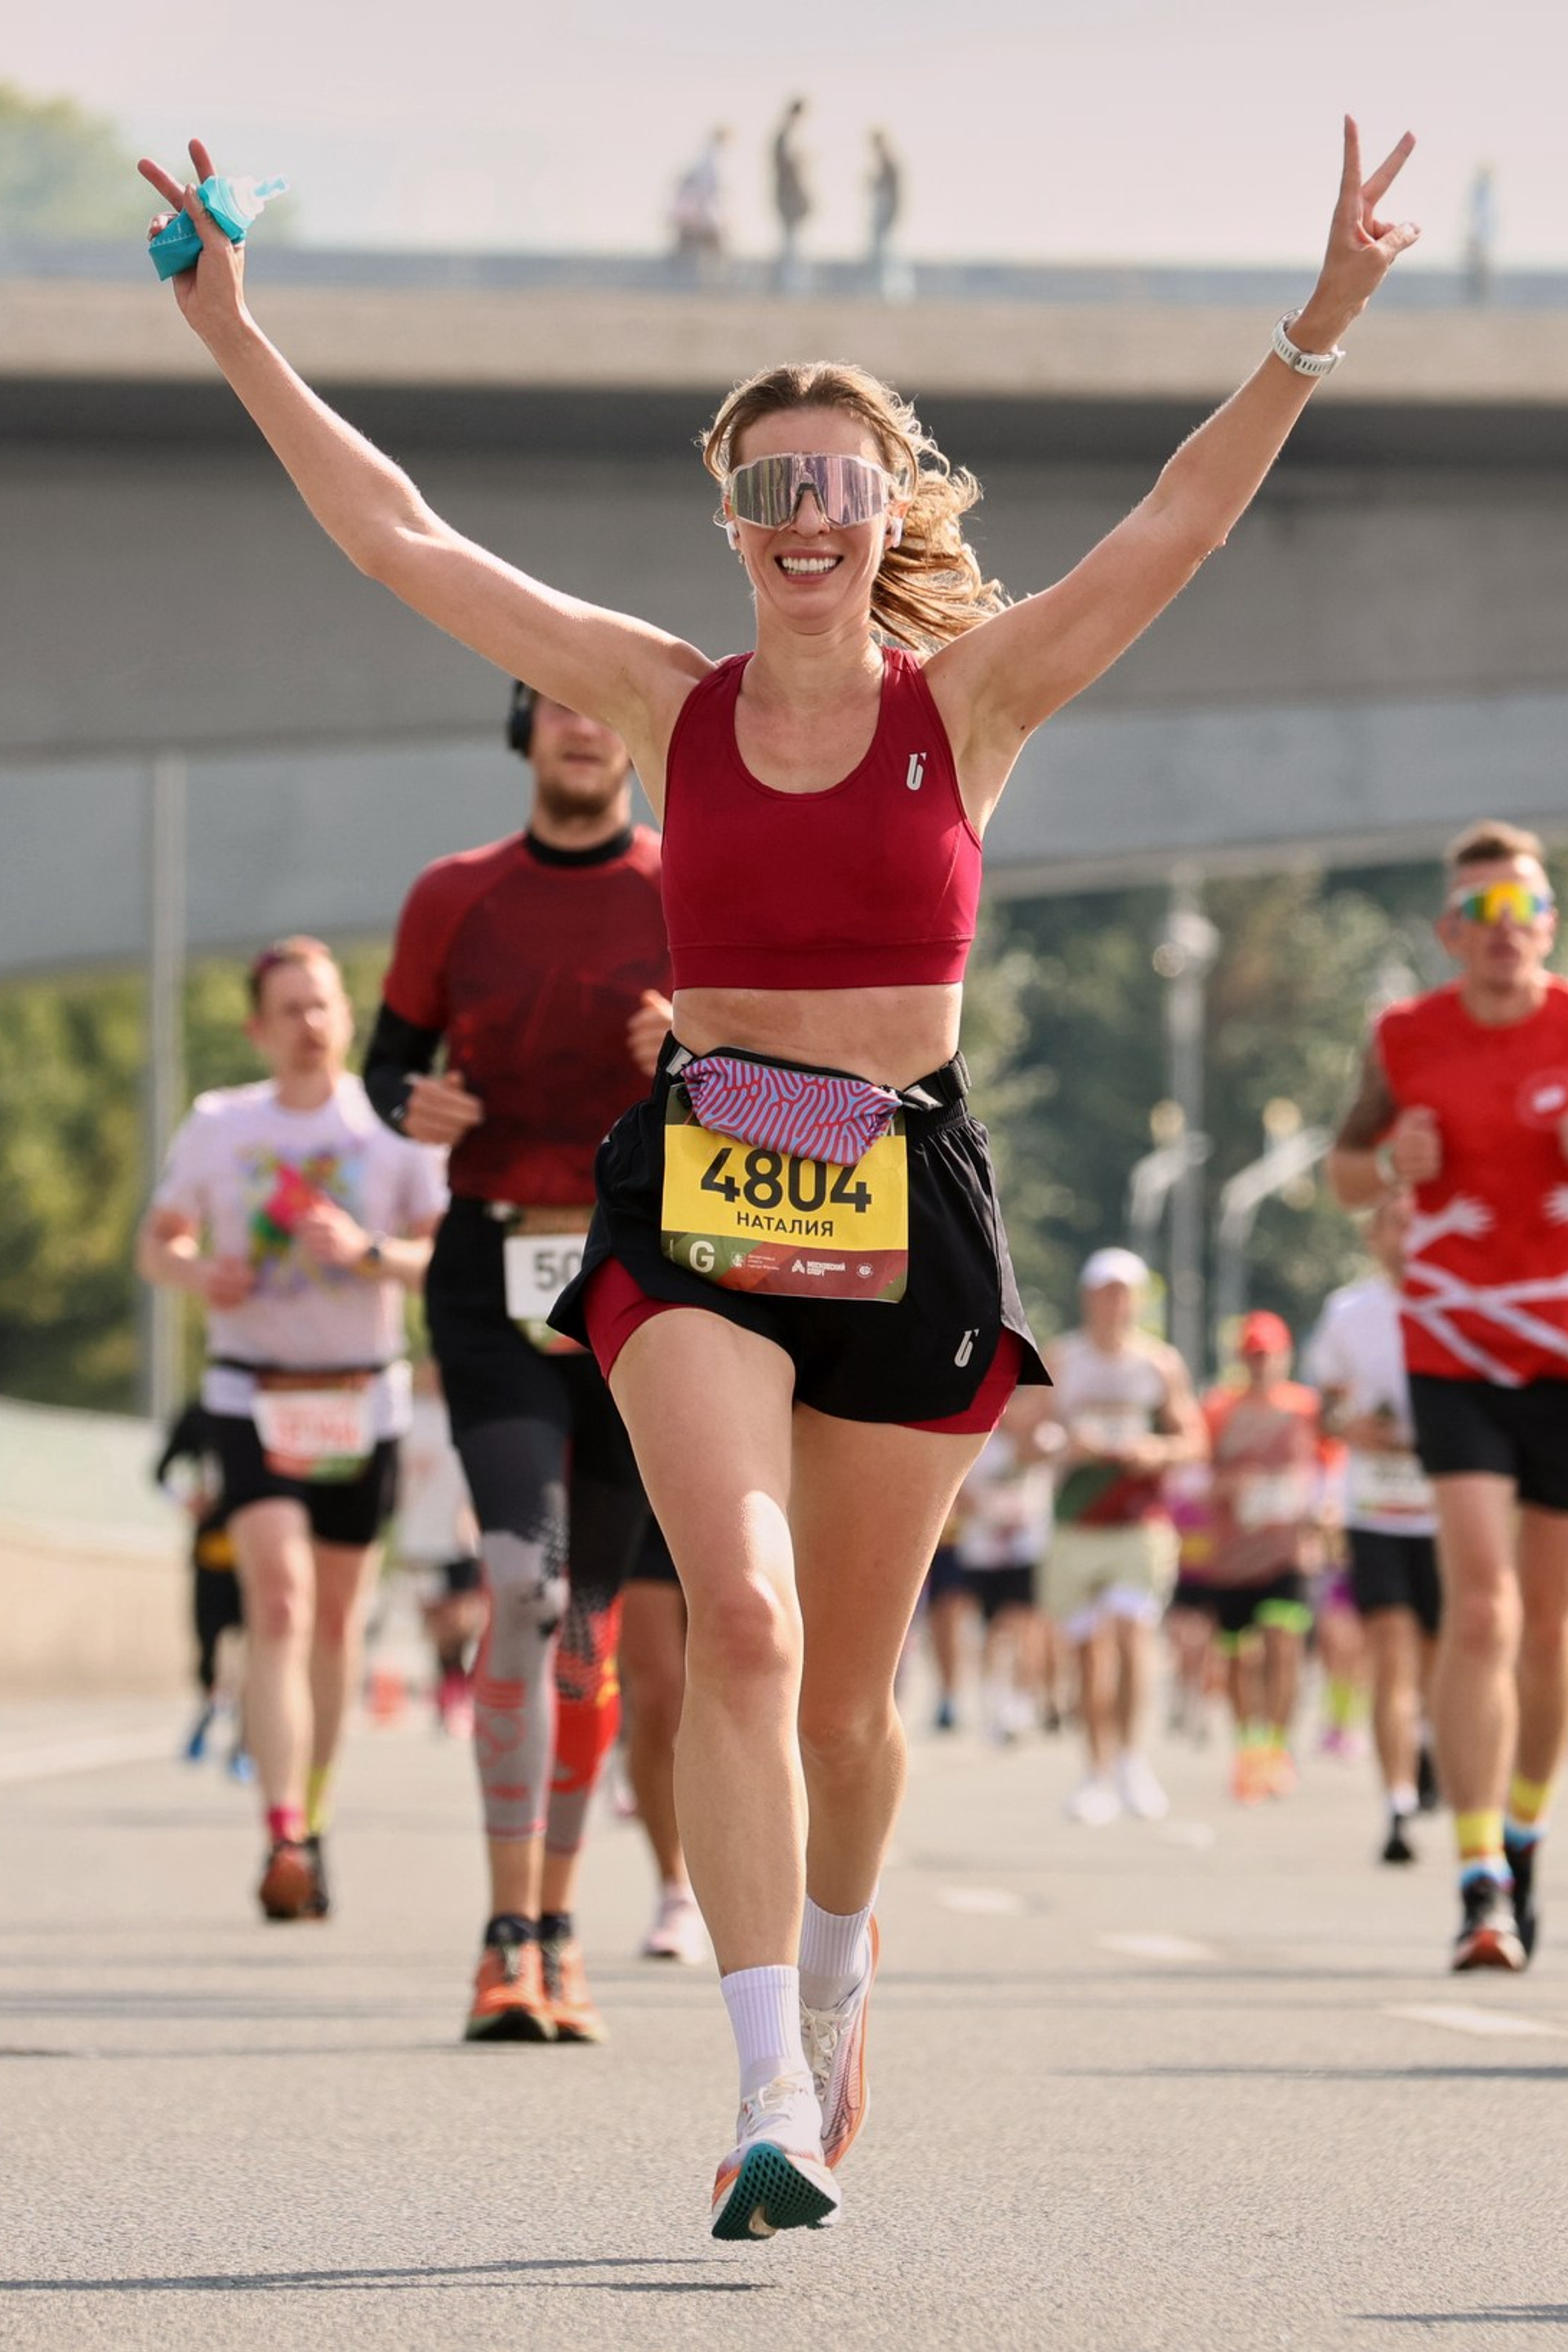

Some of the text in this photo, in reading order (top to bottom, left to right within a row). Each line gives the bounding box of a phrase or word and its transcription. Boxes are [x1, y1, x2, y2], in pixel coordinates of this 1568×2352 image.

[701, 1147, 872, 1214] 4804
[737, 1211, 834, 1237] НАТАЛИЯ
[689, 1240, 715, 1273] G
